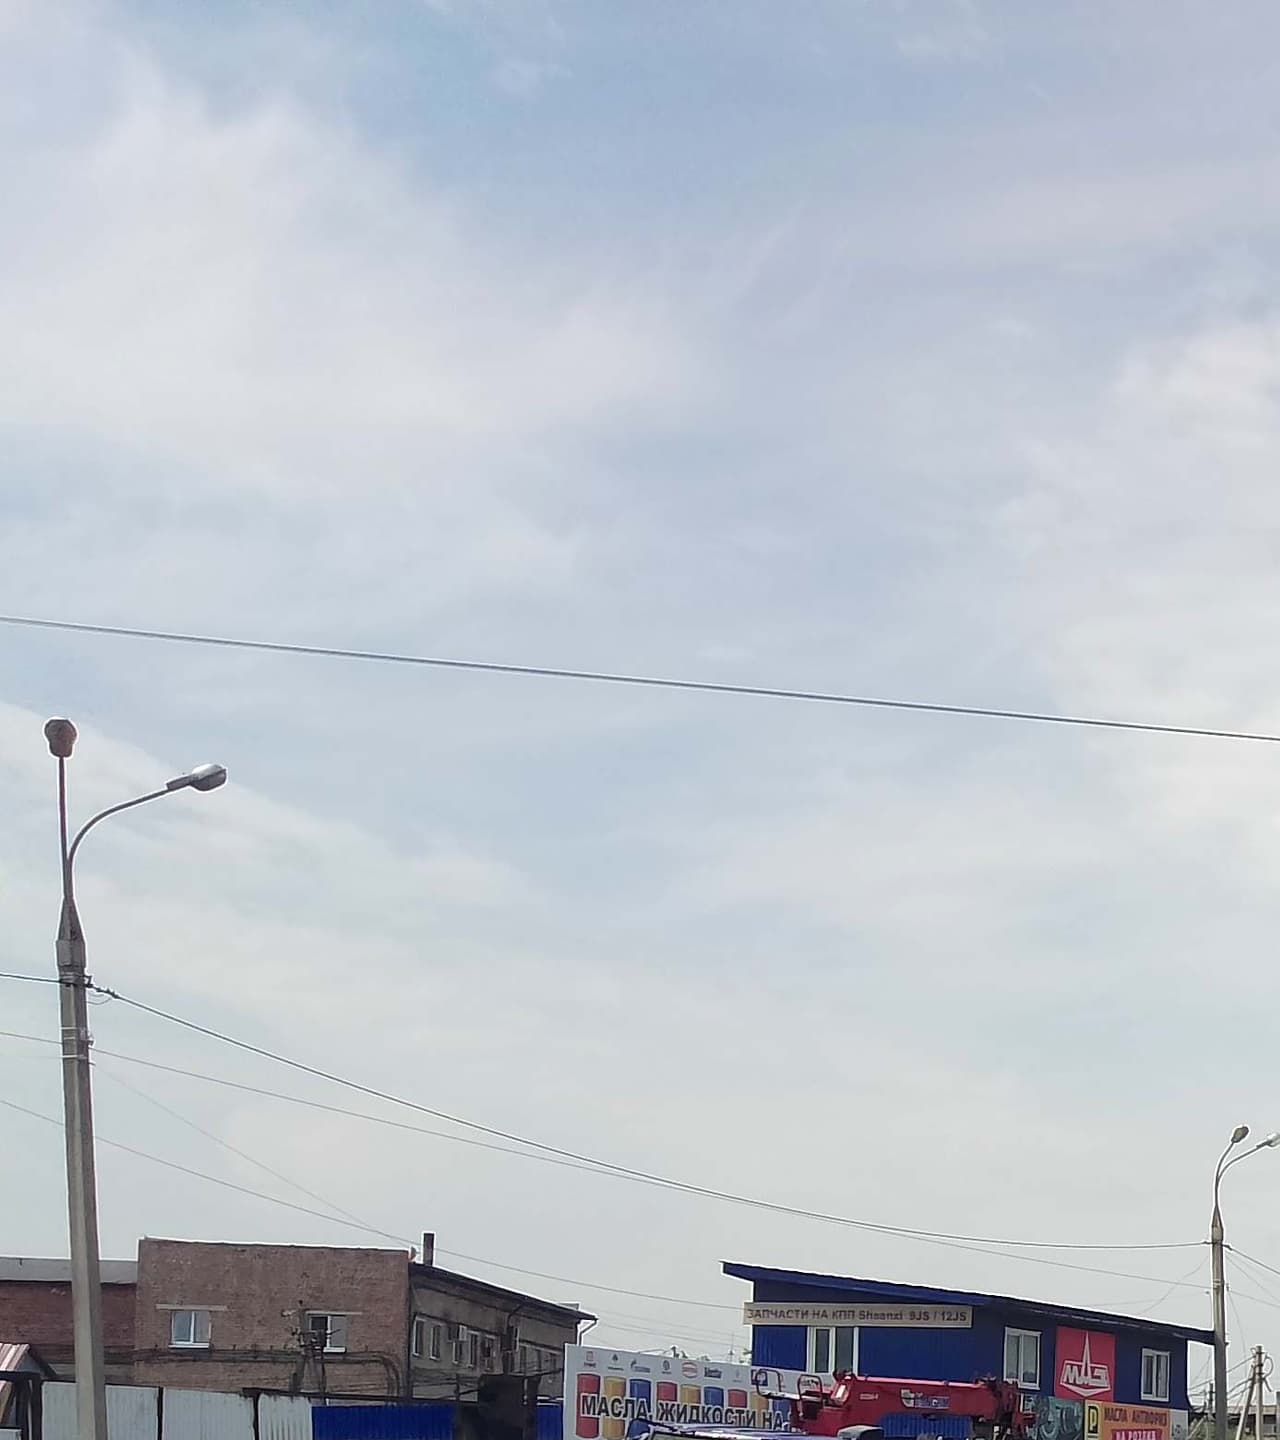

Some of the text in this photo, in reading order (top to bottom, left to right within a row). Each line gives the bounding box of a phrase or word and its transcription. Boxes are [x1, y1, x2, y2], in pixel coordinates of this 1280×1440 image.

[747, 1309, 808, 1320] ЗАПЧАСТИ
[812, 1309, 828, 1319] НА
[831, 1310, 855, 1320] КПП
[858, 1310, 903, 1321] Shaanxi
[908, 1311, 930, 1321] 9JS
[940, 1311, 967, 1322] 12JS
[657, 1402, 756, 1427] ЖИДКОСТИ
[763, 1410, 783, 1430] НА
